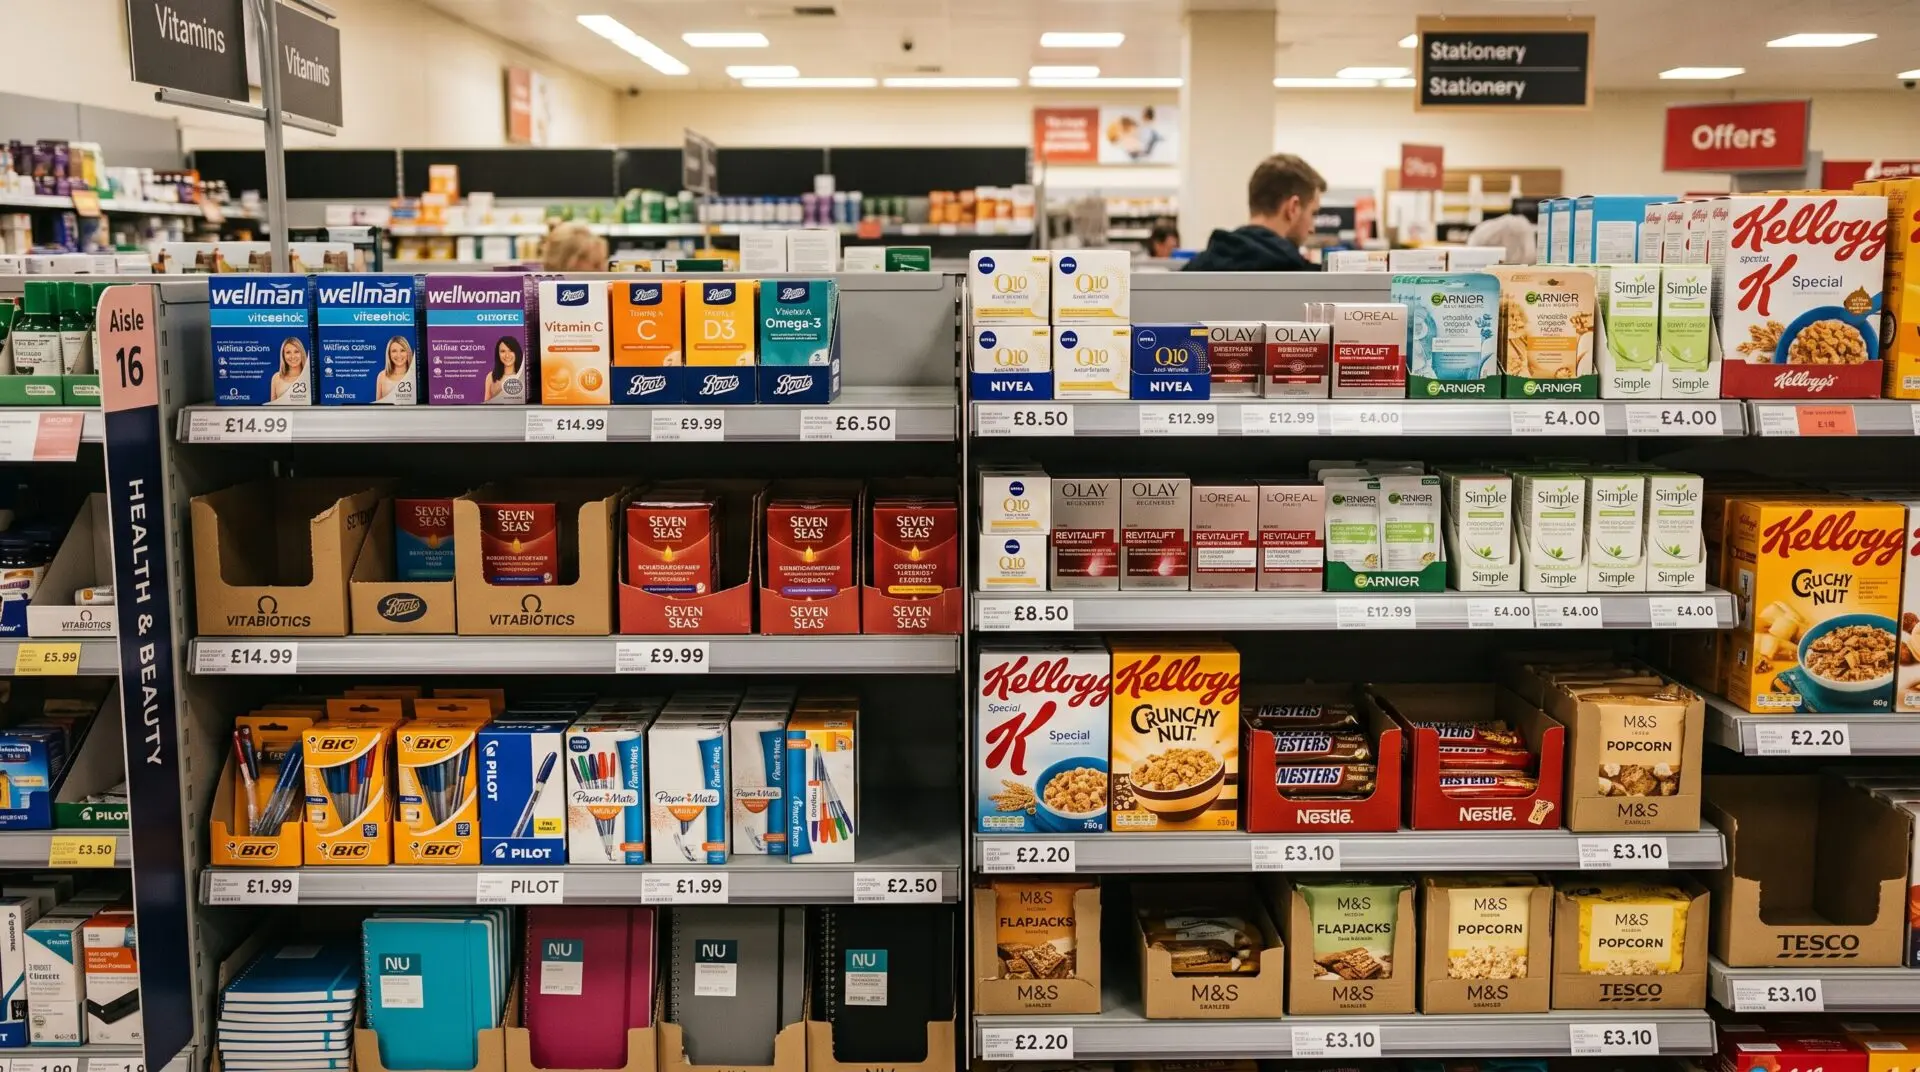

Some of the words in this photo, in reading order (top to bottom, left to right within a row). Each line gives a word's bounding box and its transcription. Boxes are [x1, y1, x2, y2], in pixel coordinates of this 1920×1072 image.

[155, 3, 225, 54] Vitamins
[1431, 41, 1526, 64] Stationery
[285, 45, 330, 86] Vitamins
[1429, 76, 1526, 100] Stationery
[1692, 123, 1777, 150] Offers
[994, 273, 1027, 293] Q10
[1075, 273, 1109, 293] Q10
[1614, 280, 1655, 296] Simple
[1666, 281, 1707, 296] Simple
[1737, 253, 1798, 316] K
[1792, 275, 1843, 290] Special
[212, 282, 304, 305] wellman
[319, 282, 412, 305] wellman
[428, 289, 521, 304] wellwoman
[1431, 293, 1484, 305] GARNIER
[1525, 293, 1579, 304] GARNIER
[110, 308, 144, 333] Aisle
[544, 320, 592, 332] Vitamin
[594, 321, 604, 332] C
[765, 318, 822, 330] Omega-3
[637, 319, 657, 340] C
[703, 319, 735, 340] D3
[1211, 328, 1256, 342] OLAY
[1275, 328, 1321, 342] OLAY
[995, 347, 1028, 367] Q10
[1076, 347, 1109, 367] Q10
[1155, 347, 1188, 366] Q10
[1339, 347, 1389, 356] REVITALIFT
[115, 345, 144, 388] 16
[627, 374, 666, 395] Boots
[699, 374, 740, 395] Boots
[773, 373, 813, 395] Boots
[991, 380, 1034, 392] NIVEA
[1150, 380, 1193, 392] NIVEA
[1427, 380, 1485, 395] GARNIER
[1523, 380, 1582, 395] GARNIER
[1614, 377, 1651, 391] Simple
[1672, 377, 1709, 392] Simple
[1773, 371, 1837, 393] Kellogg's
[556, 418, 605, 430] £14.99
[680, 418, 722, 430] £9.99
[836, 416, 891, 431] £6.50
[1013, 411, 1068, 426] £8.50
[1168, 412, 1215, 424] £12.99
[1269, 412, 1315, 424] £12.99
[1360, 412, 1399, 424] £4.00
[1544, 410, 1600, 425] £4.00
[1661, 410, 1717, 425] £4.00
[225, 418, 288, 433] £14.99
[1062, 482, 1109, 497] OLAY
[1132, 482, 1179, 497] OLAY
[1597, 489, 1638, 504] Simple
[1655, 489, 1697, 504] Simple
[1465, 490, 1507, 505] Simple
[1537, 491, 1579, 506] Simple
[415, 506, 450, 516] SEVEN
[498, 510, 535, 521] SEVEN
[419, 517, 447, 527] SEAS
[502, 521, 532, 532] SEAS
[649, 516, 687, 527] SEVEN
[790, 516, 828, 528] SEVEN
[896, 516, 935, 527] SEVEN
[653, 527, 683, 538] SEAS
[794, 528, 825, 539] SEAS
[900, 527, 931, 538] SEAS
[1055, 531, 1106, 540] REVITALIFT
[1126, 531, 1175, 540] REVITALIFT
[129, 478, 152, 604] HEALTH
[1813, 589, 1849, 606] NUT
[664, 606, 703, 617] SEVEN
[1014, 606, 1069, 621] £8.50
[1367, 606, 1412, 617] £12.99
[1494, 606, 1530, 617] £4.00
[1562, 606, 1599, 617] £4.00
[62, 621, 111, 629] VITABIOTICS
[138, 613, 153, 637] &
[226, 615, 311, 628] VITABIOTICS
[489, 614, 575, 626] VITABIOTICS
[668, 617, 700, 628] SEAS
[44, 652, 77, 662] £5.99
[231, 648, 293, 664] £14.99
[650, 648, 704, 663] £9.99
[139, 643, 162, 765] BEAUTY
[988, 703, 1020, 713] Special
[1258, 704, 1321, 717] NESTERS
[1130, 703, 1220, 735] CRUNCHY
[1624, 715, 1657, 728] M&S
[985, 700, 1057, 776] K
[1049, 730, 1090, 741] Special
[1158, 724, 1197, 743] NUT
[1791, 730, 1845, 746] £2.20
[1607, 740, 1672, 752] POPCORN
[486, 759, 498, 802] PILOT
[1276, 767, 1341, 784] NESTERS
[572, 790, 604, 804] Paper
[610, 793, 636, 804] Mate
[655, 790, 687, 804] Paper
[691, 793, 718, 804] Mate
[734, 788, 758, 799] Paper
[95, 811, 129, 821] PILOT
[1618, 803, 1659, 817] M&S
[78, 844, 112, 855] £3.50
[511, 848, 552, 859] PILOT
[1016, 847, 1070, 863] £2.20
[1285, 845, 1335, 861] £3.10
[1613, 843, 1662, 859] £3.10
[246, 878, 292, 894] £1.99
[511, 880, 560, 894] PILOT
[676, 878, 722, 894] £1.99
[887, 878, 937, 894] £2.50
[1020, 891, 1053, 904] M&S
[1337, 896, 1371, 910] M&S
[1474, 897, 1507, 911] M&S
[1000, 917, 1074, 929] FLAPJACKS
[1317, 922, 1391, 935] FLAPJACKS
[1457, 923, 1523, 935] POPCORN
[548, 943, 572, 956] NU
[1598, 937, 1664, 948] POPCORN
[1776, 934, 1860, 951] TESCO
[702, 944, 726, 958] NU
[384, 957, 410, 971] NU
[851, 953, 876, 967] NU
[1018, 984, 1059, 1000] M&S
[1332, 985, 1374, 1001] M&S
[1467, 984, 1509, 1000] M&S
[1600, 983, 1663, 997] TESCO
[1767, 986, 1817, 1002] £3.10
[1325, 1031, 1375, 1048] £3.10
